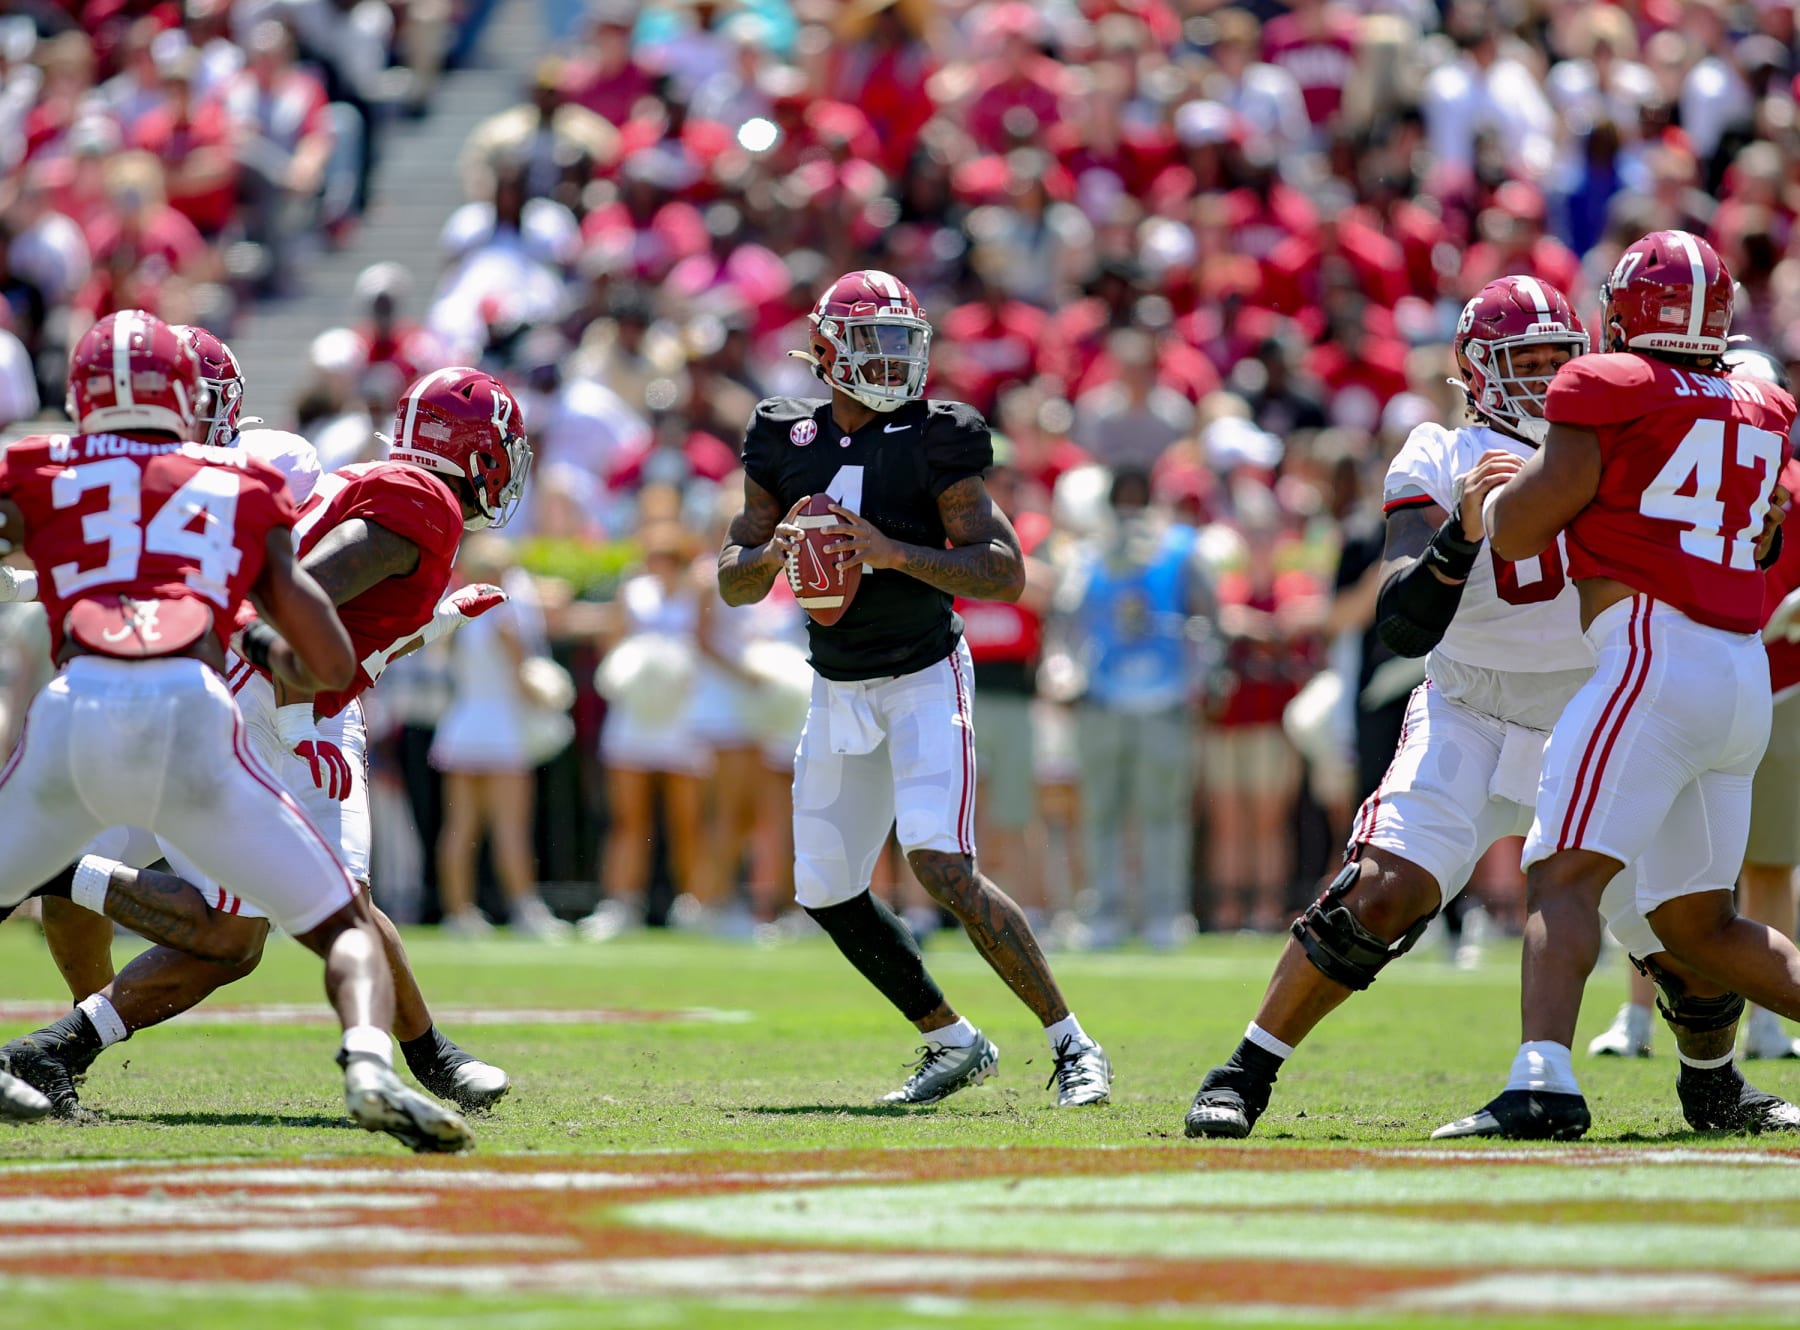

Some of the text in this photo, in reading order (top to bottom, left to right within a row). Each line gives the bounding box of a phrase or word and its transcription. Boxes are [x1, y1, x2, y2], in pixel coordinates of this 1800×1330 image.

[1610, 252, 1644, 289] 47
[1650, 339, 1720, 351] CRIMSON TIDE
[1670, 368, 1766, 406] J. SMITH
[792, 420, 816, 444] SEC
[414, 455, 438, 468] TIDE
[1639, 417, 1783, 572] 47
[51, 456, 243, 610] 34
